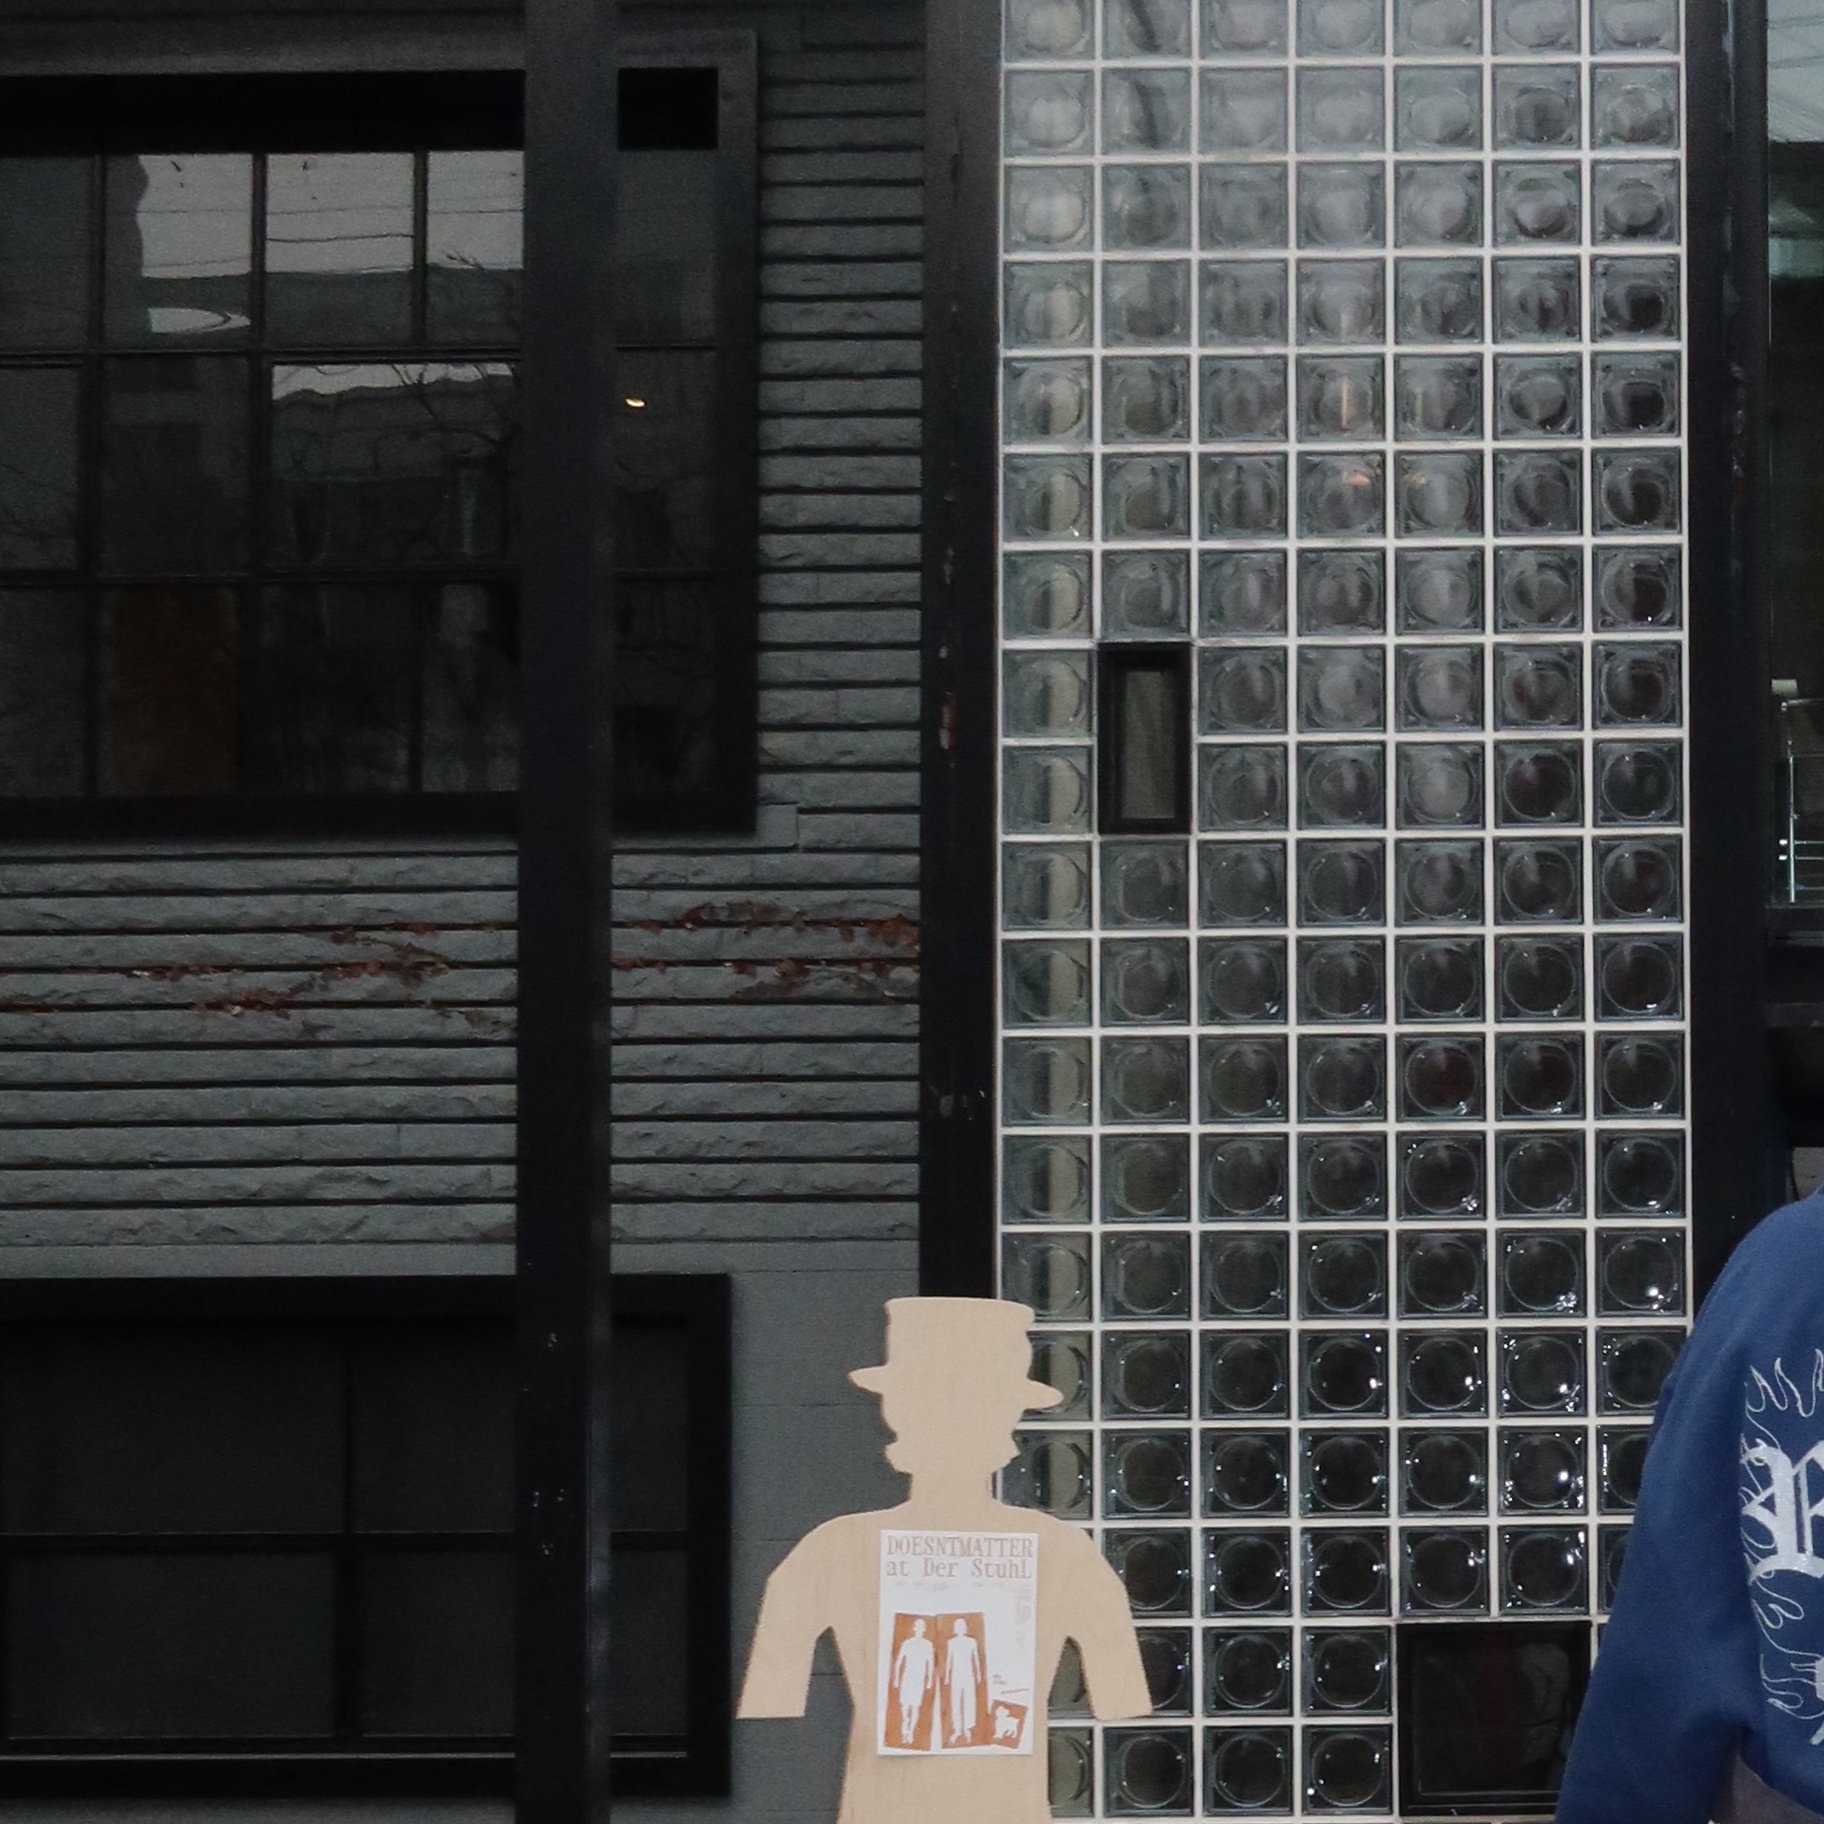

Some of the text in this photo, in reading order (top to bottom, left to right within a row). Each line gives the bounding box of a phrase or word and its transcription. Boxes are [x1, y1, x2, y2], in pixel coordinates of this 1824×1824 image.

[886, 1534, 1033, 1558] DOESNTMATTER
[886, 1559, 911, 1578] at
[923, 1557, 958, 1578] Der
